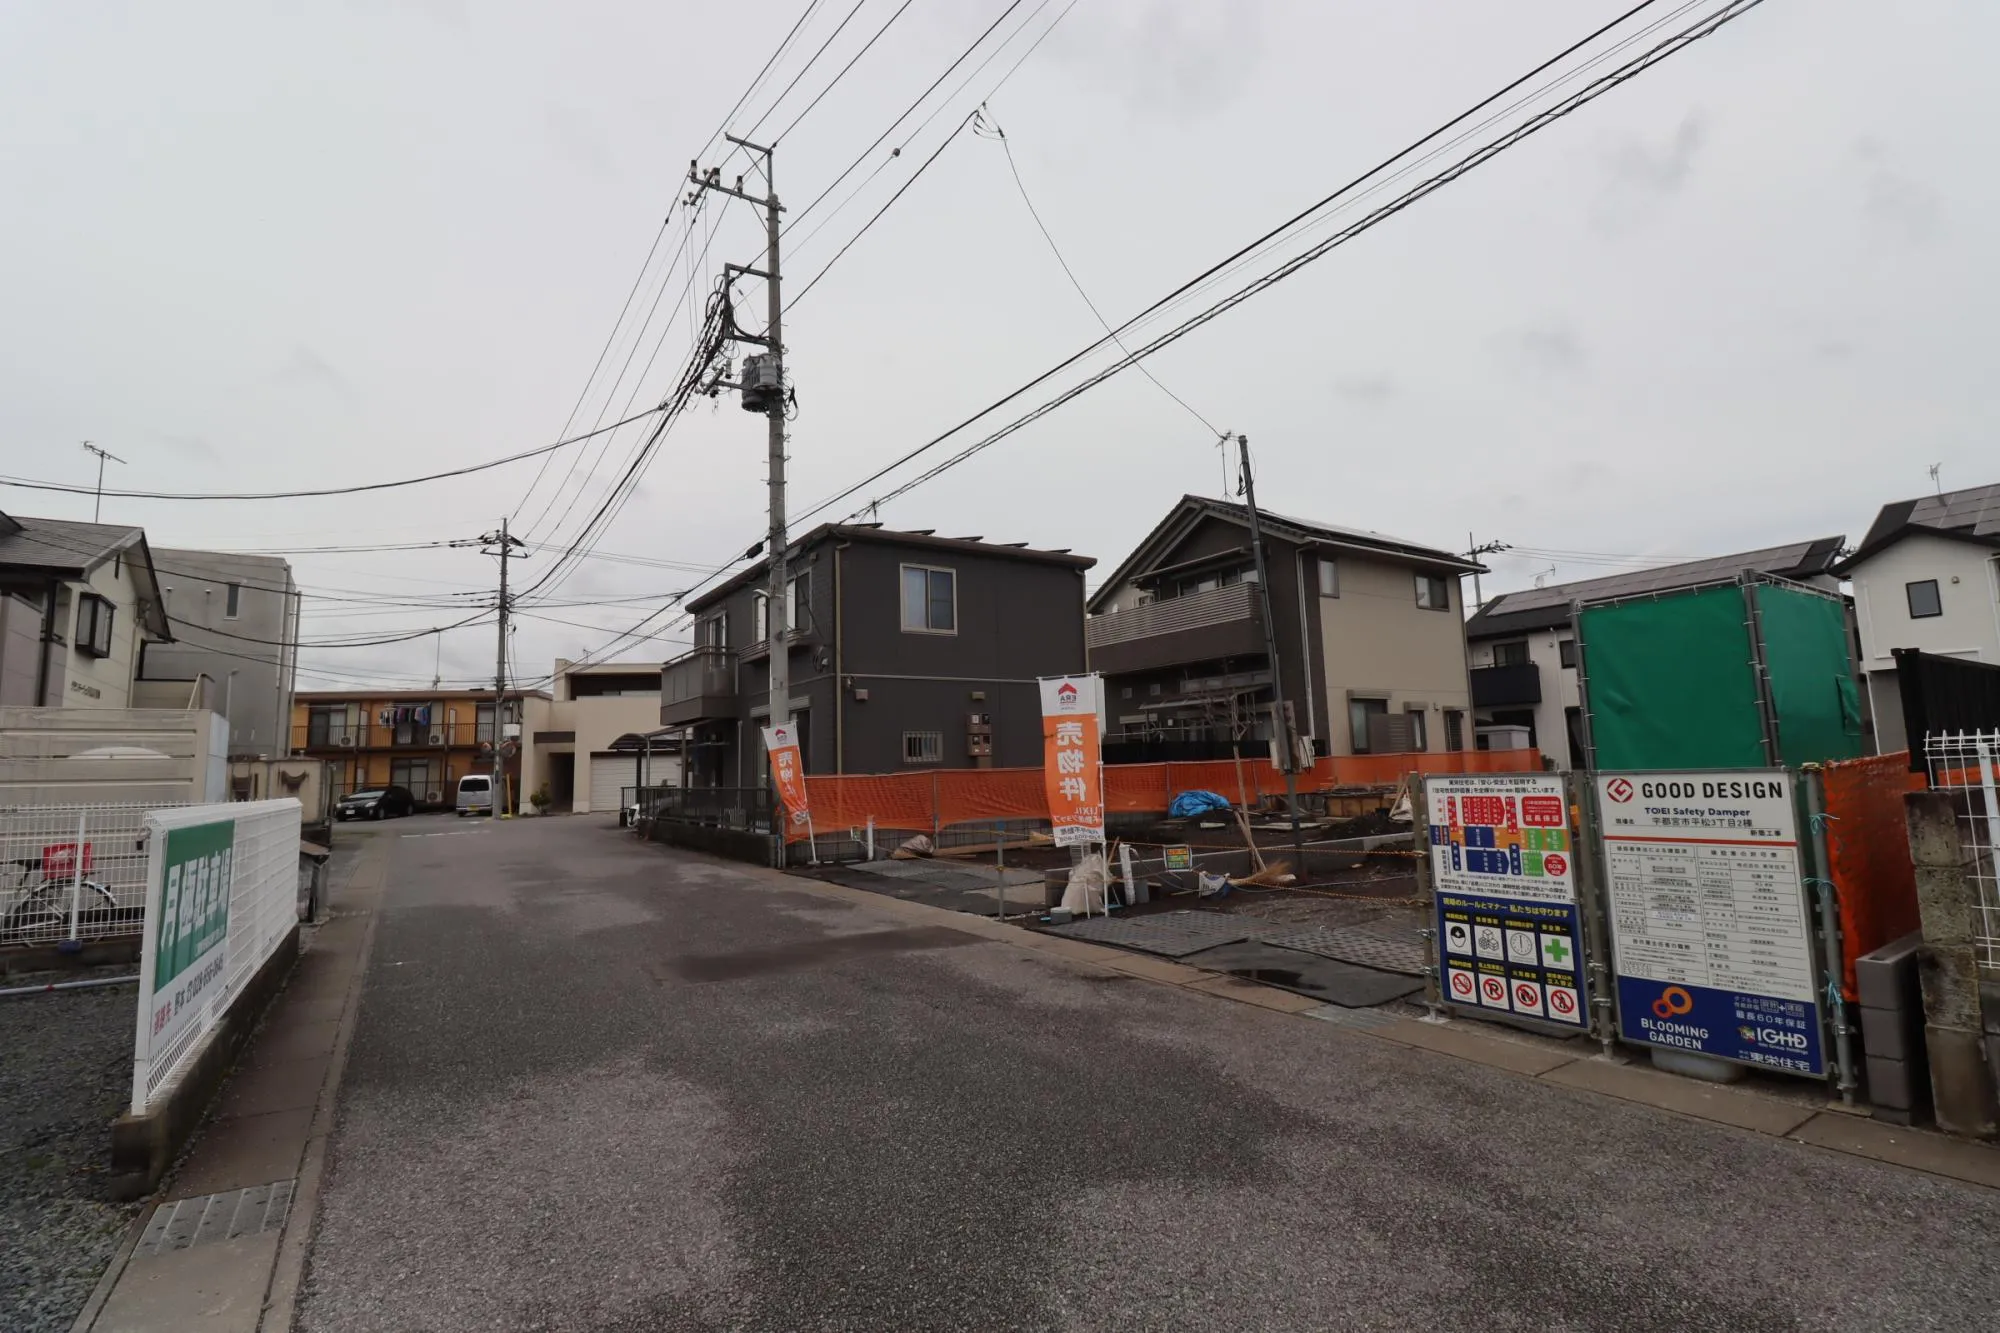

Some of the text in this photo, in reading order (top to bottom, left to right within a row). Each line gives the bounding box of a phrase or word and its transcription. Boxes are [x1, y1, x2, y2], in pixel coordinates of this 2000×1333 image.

[1642, 781, 1783, 799] GOOD DESIGN
[1673, 808, 1705, 817] Safety
[1708, 807, 1751, 817] Damper
[161, 848, 232, 951] 月極駐車場
[1509, 904, 1568, 918] 私たちは守ります
[1640, 1018, 1709, 1038] BLOOMING
[1736, 1010, 1806, 1029] 最長60年保証
[1649, 1031, 1702, 1050] GARDEN
[1757, 1027, 1808, 1049] IGHD
[1750, 1052, 1811, 1072] 東栄住宅
